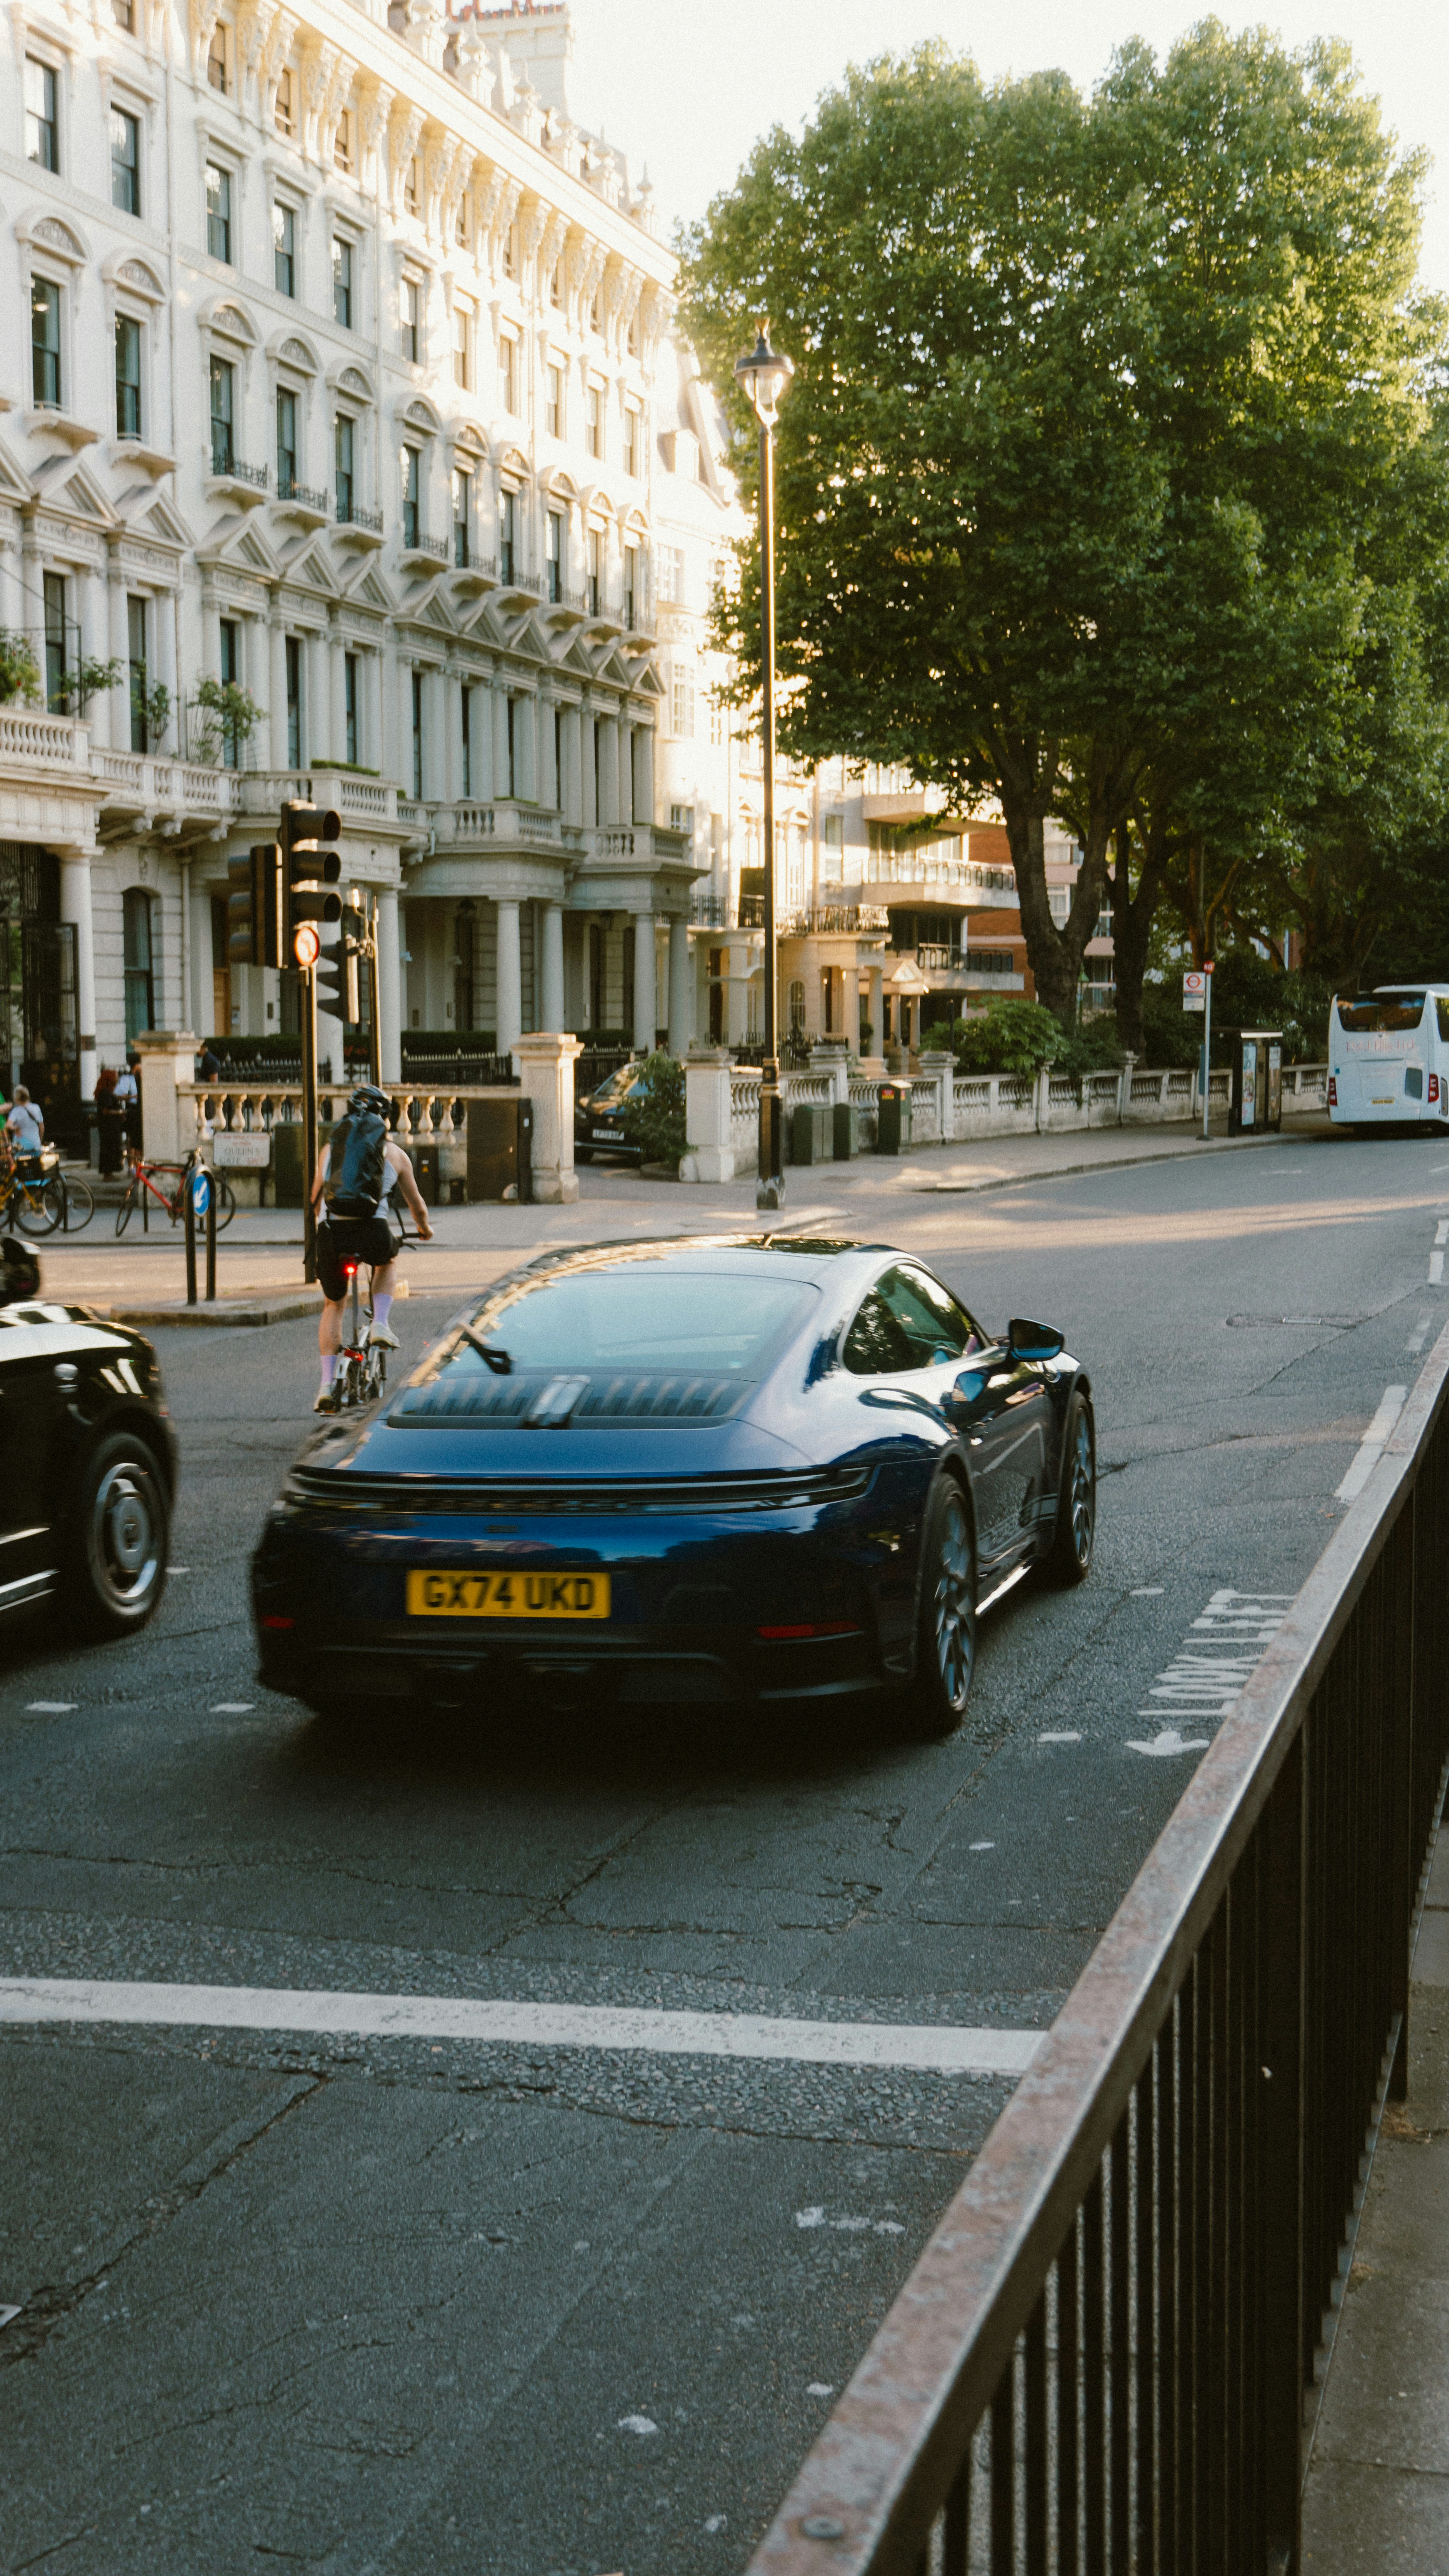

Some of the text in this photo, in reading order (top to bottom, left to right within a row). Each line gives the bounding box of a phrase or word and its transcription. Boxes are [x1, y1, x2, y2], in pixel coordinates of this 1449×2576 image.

[423, 1575, 595, 1611] GX74 UKD
[1137, 1589, 1297, 1716] LOOK LEFT
